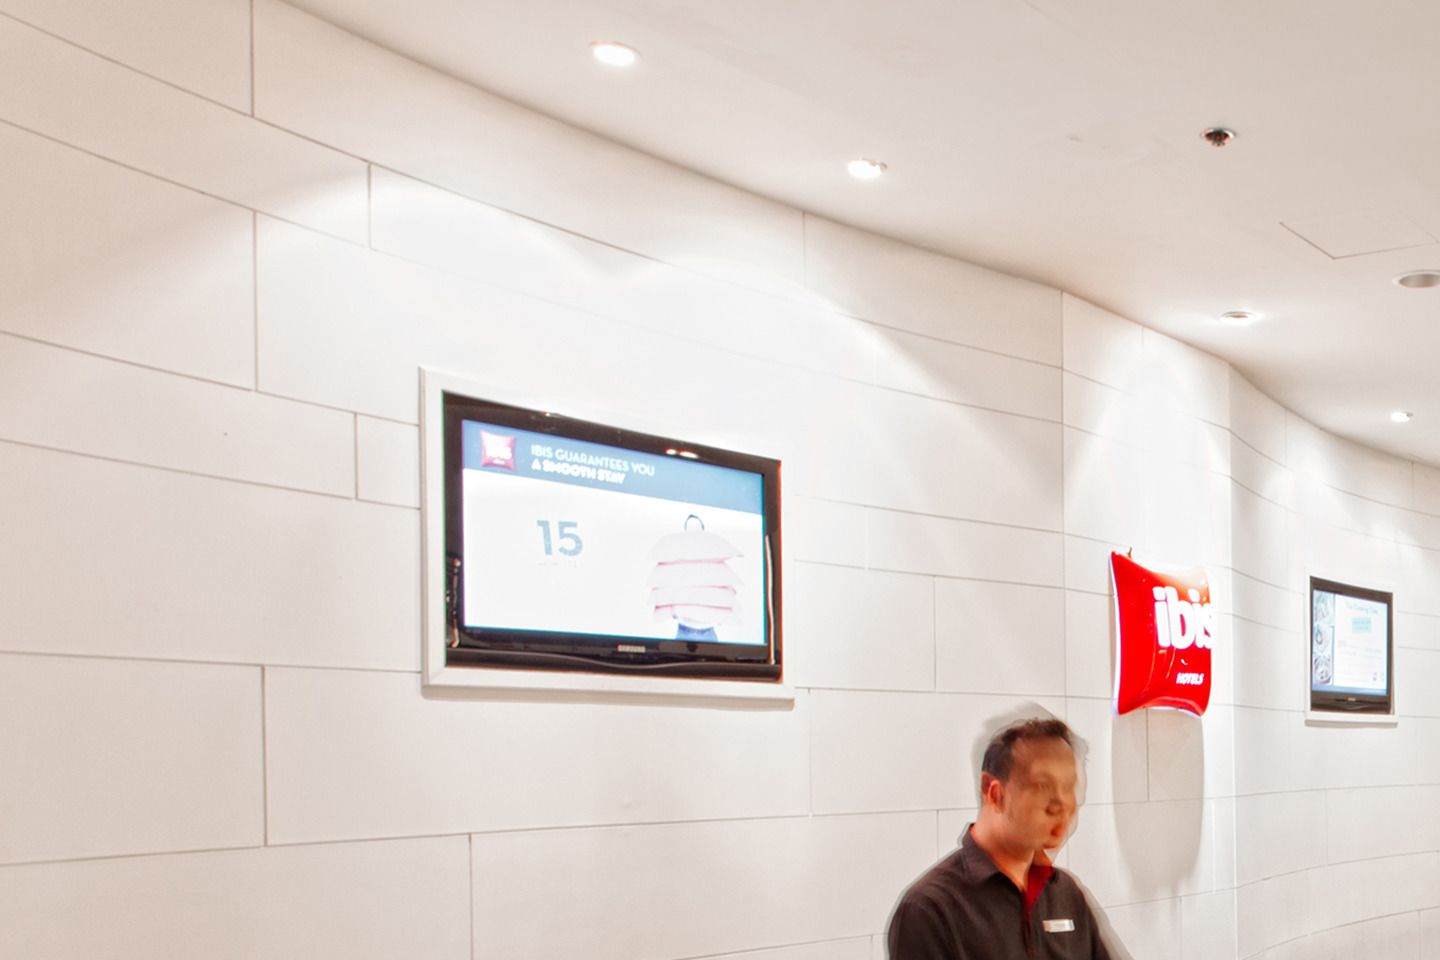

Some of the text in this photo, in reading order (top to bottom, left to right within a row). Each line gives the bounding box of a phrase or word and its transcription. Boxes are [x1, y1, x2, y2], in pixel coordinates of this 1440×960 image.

[531, 444, 655, 477] IBIS GUARANTEES YOU
[531, 458, 625, 485] A SMOOTH STAY
[536, 519, 583, 557] 15
[1176, 672, 1204, 685] HOTELS
